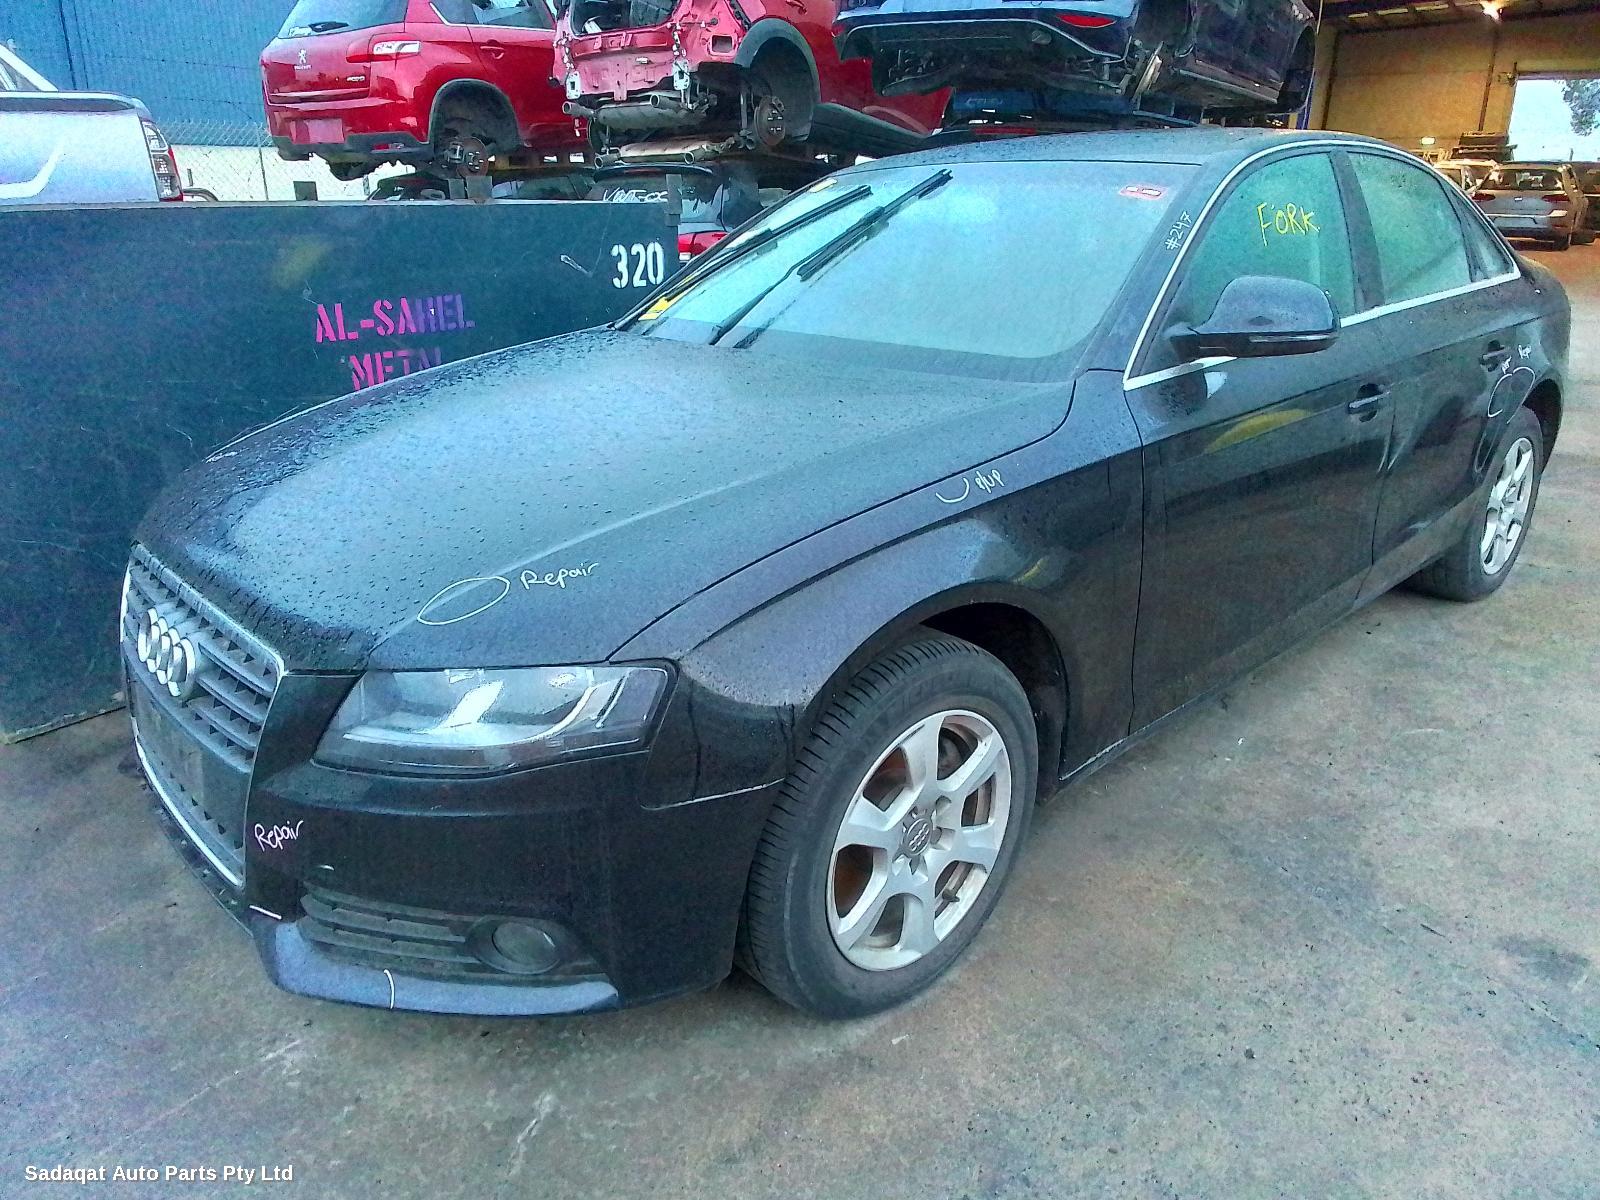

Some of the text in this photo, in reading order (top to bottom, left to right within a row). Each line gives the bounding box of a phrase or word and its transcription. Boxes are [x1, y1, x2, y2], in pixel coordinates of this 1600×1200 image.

[1164, 210, 1192, 250] #247
[1257, 202, 1321, 247] FORK
[611, 241, 664, 289] 320
[315, 294, 476, 343] AL-SAHEL
[520, 561, 599, 590] Repair
[254, 819, 304, 852] Repair
